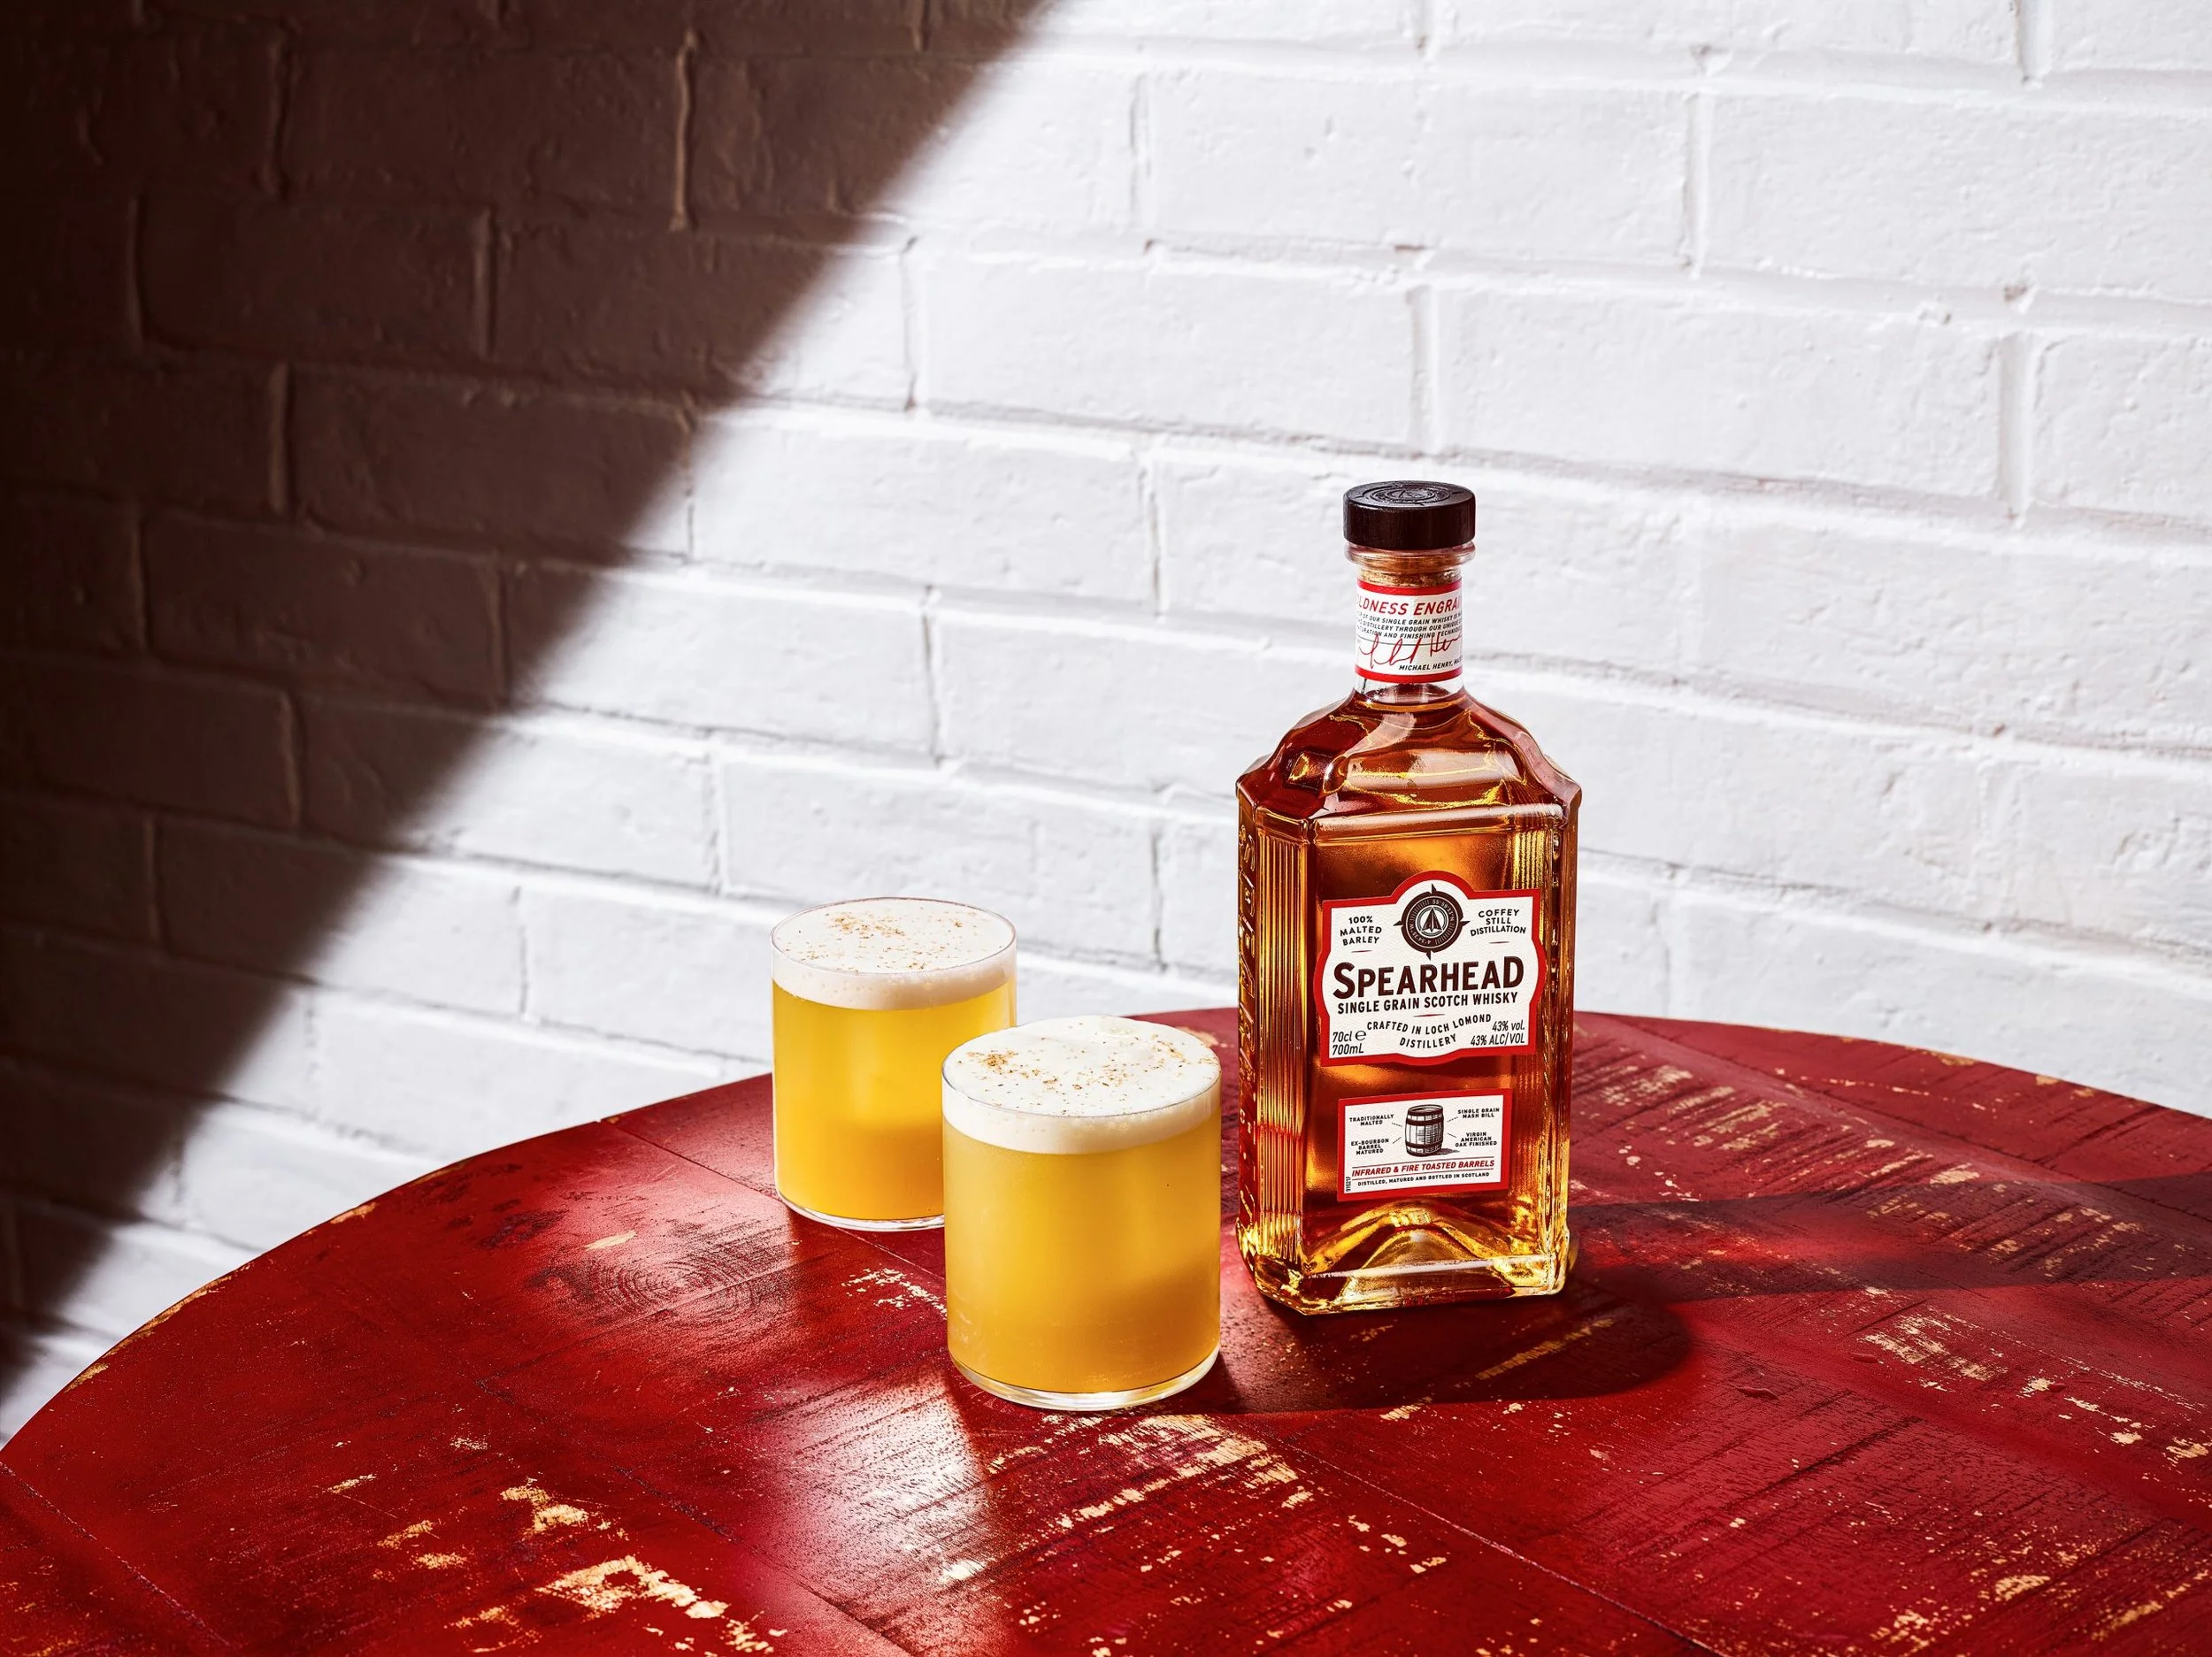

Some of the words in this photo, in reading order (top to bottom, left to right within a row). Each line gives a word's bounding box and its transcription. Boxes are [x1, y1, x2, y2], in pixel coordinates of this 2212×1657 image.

[1357, 595, 1409, 615] LDNESS
[1432, 615, 1454, 624] WHISKY
[1363, 620, 1394, 632] DISTILLERY
[1442, 620, 1459, 629] UNIQUE
[1432, 660, 1453, 670] HENRY,
[1478, 909, 1520, 917] COFFEY
[1348, 915, 1373, 924] 100%
[1340, 925, 1382, 936] MALTED
[1471, 926, 1527, 937] DISTILLATION
[1342, 936, 1380, 946] BARLEY
[1333, 955, 1525, 1000] SPEARHEAD
[1338, 1001, 1380, 1015] SINGLE
[1383, 998, 1420, 1011] GRAIN
[1424, 995, 1469, 1009] SCOTCH
[1472, 992, 1518, 1006] WHISKY
[1366, 1021, 1409, 1032] CRAFTED
[1411, 1025, 1421, 1035] IN
[1425, 1023, 1449, 1035] LOCH
[1452, 1014, 1492, 1029] LOMOND
[1492, 1021, 1509, 1032] 43%
[1510, 1020, 1525, 1031] vol.
[1333, 1031, 1353, 1043] 70cl
[1399, 1033, 1457, 1048] DISTILLERY
[1471, 1036, 1487, 1047] 43%
[1488, 1032, 1525, 1046] ALC/VOL
[1332, 1042, 1364, 1055] 700mL
[1349, 1114, 1394, 1123] TRADITIONALLY
[1352, 1167, 1392, 1178] INFRARED
[1421, 1162, 1456, 1170] TOASTED
[1458, 1160, 1494, 1169] BARRELS
